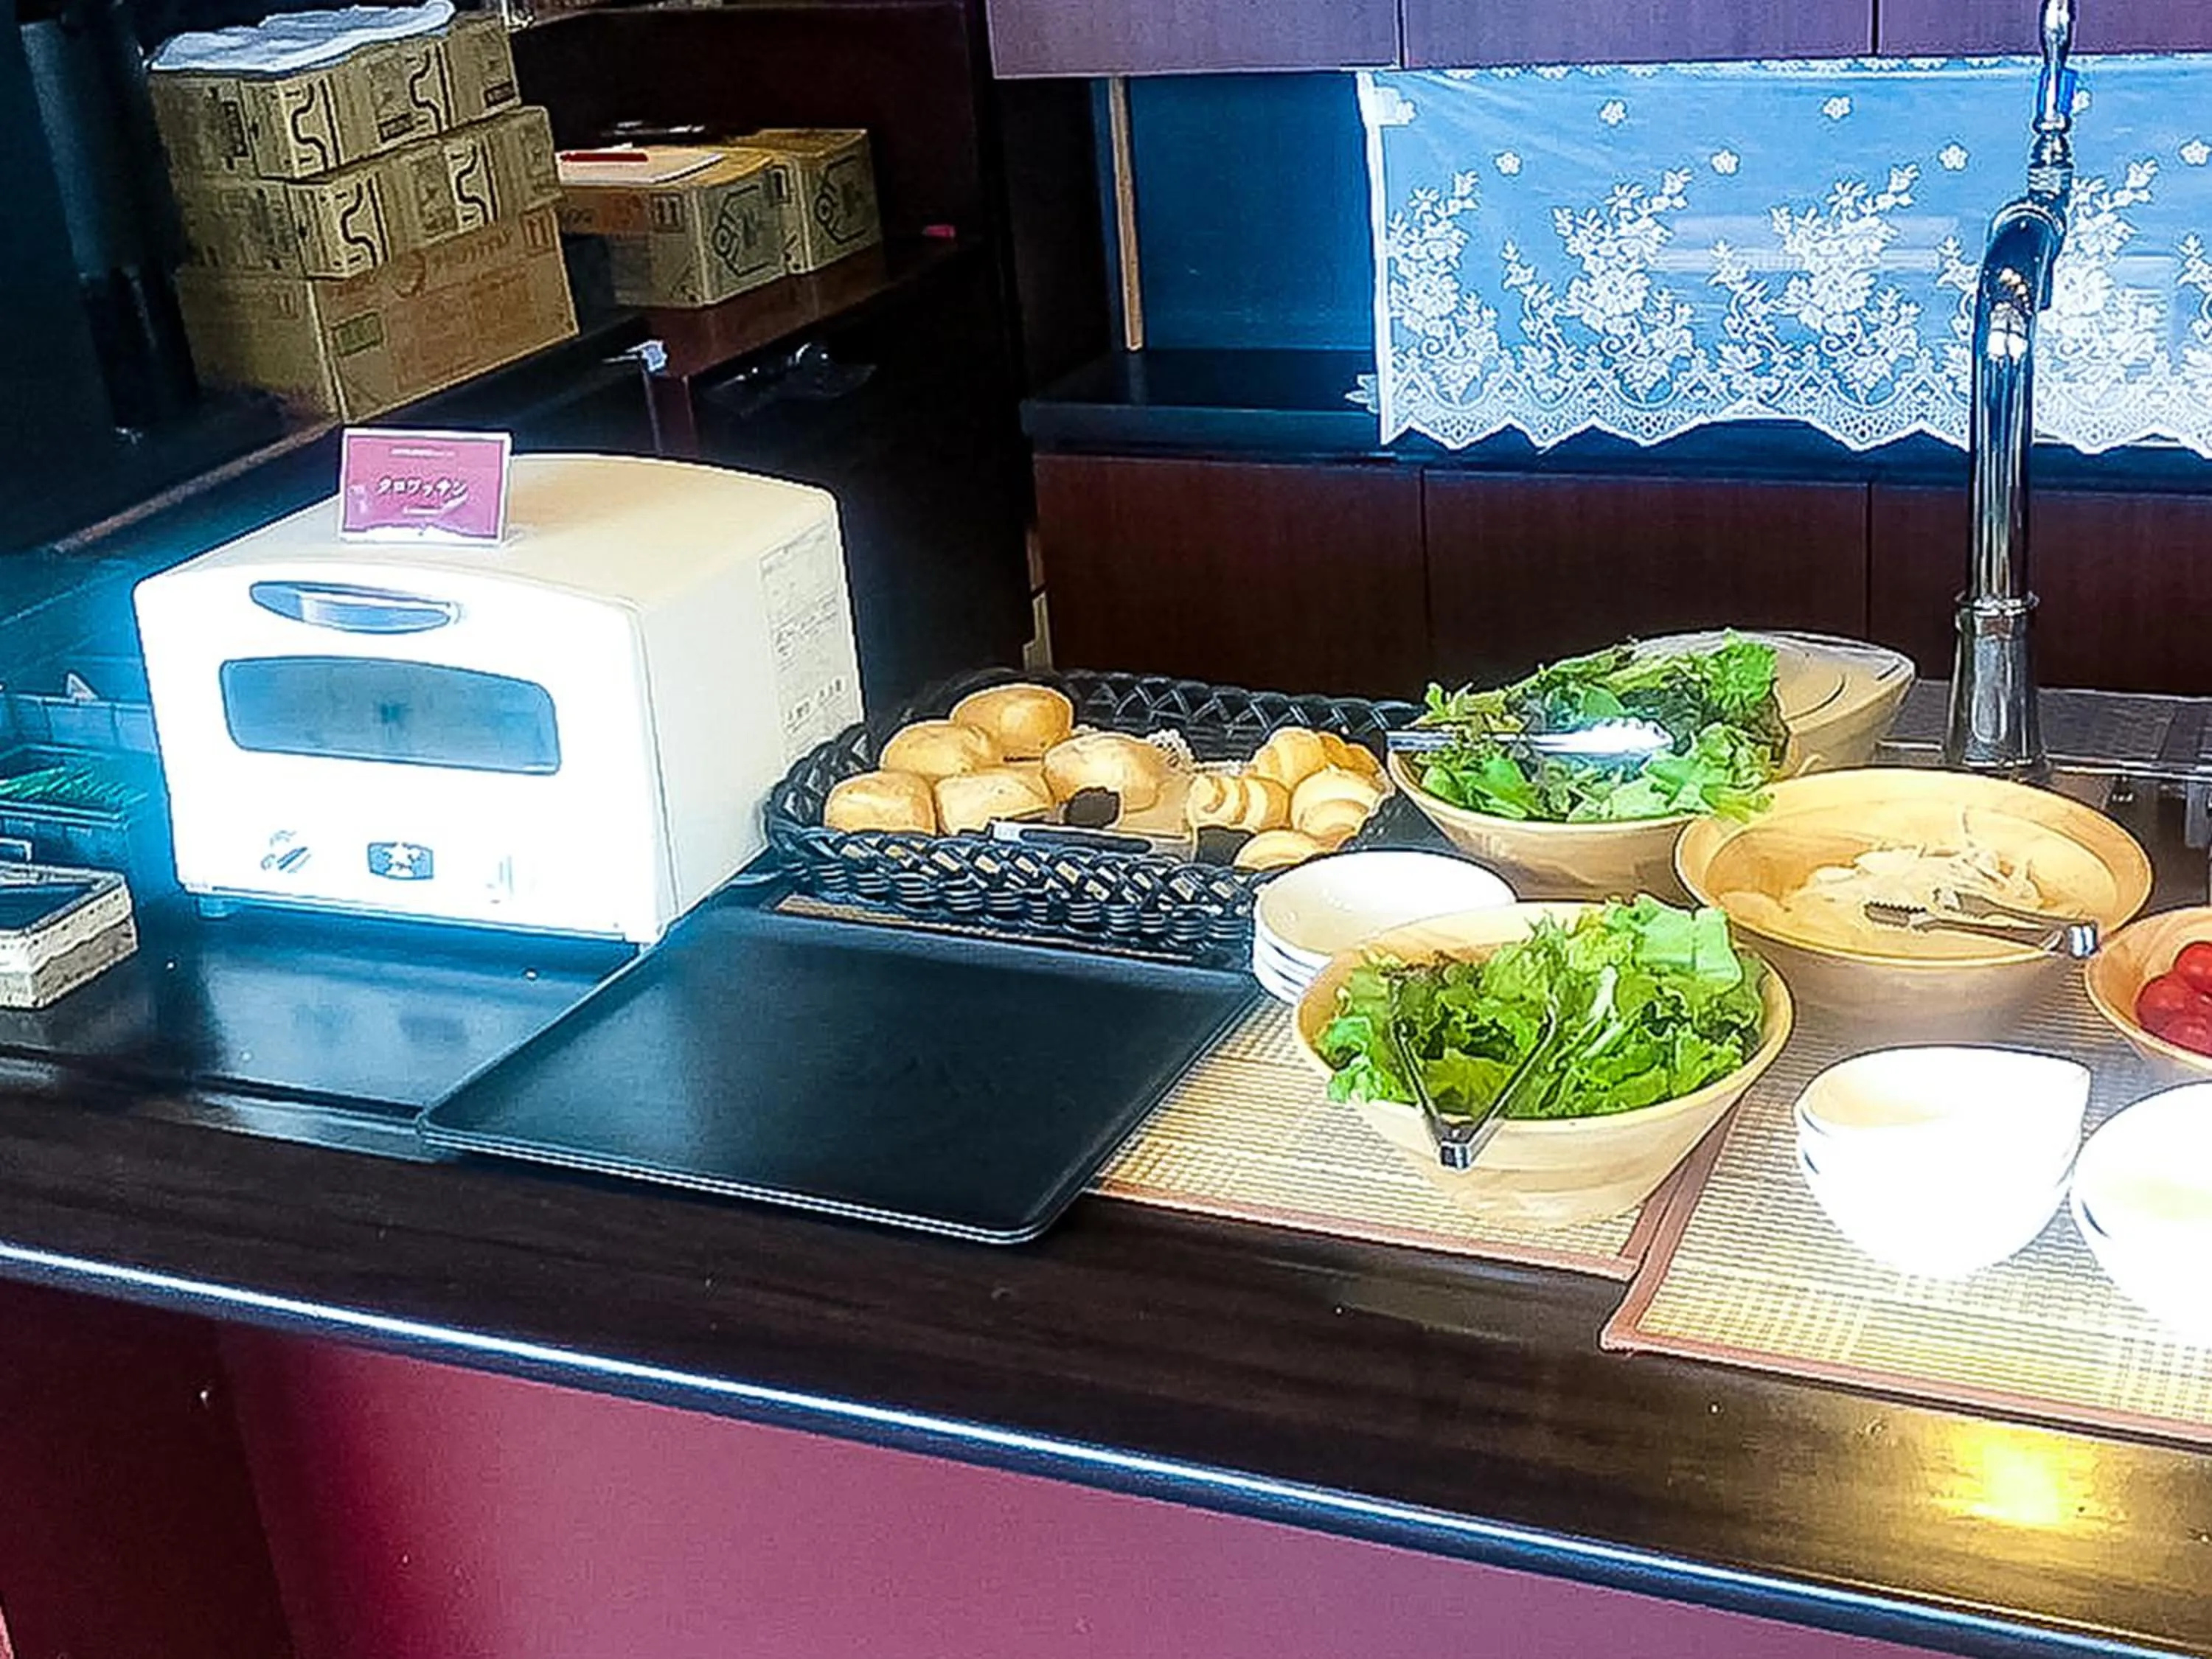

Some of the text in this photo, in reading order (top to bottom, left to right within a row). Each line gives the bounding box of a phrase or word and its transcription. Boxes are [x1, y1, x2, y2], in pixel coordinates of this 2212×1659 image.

[377, 477, 468, 497] クロワッサン
